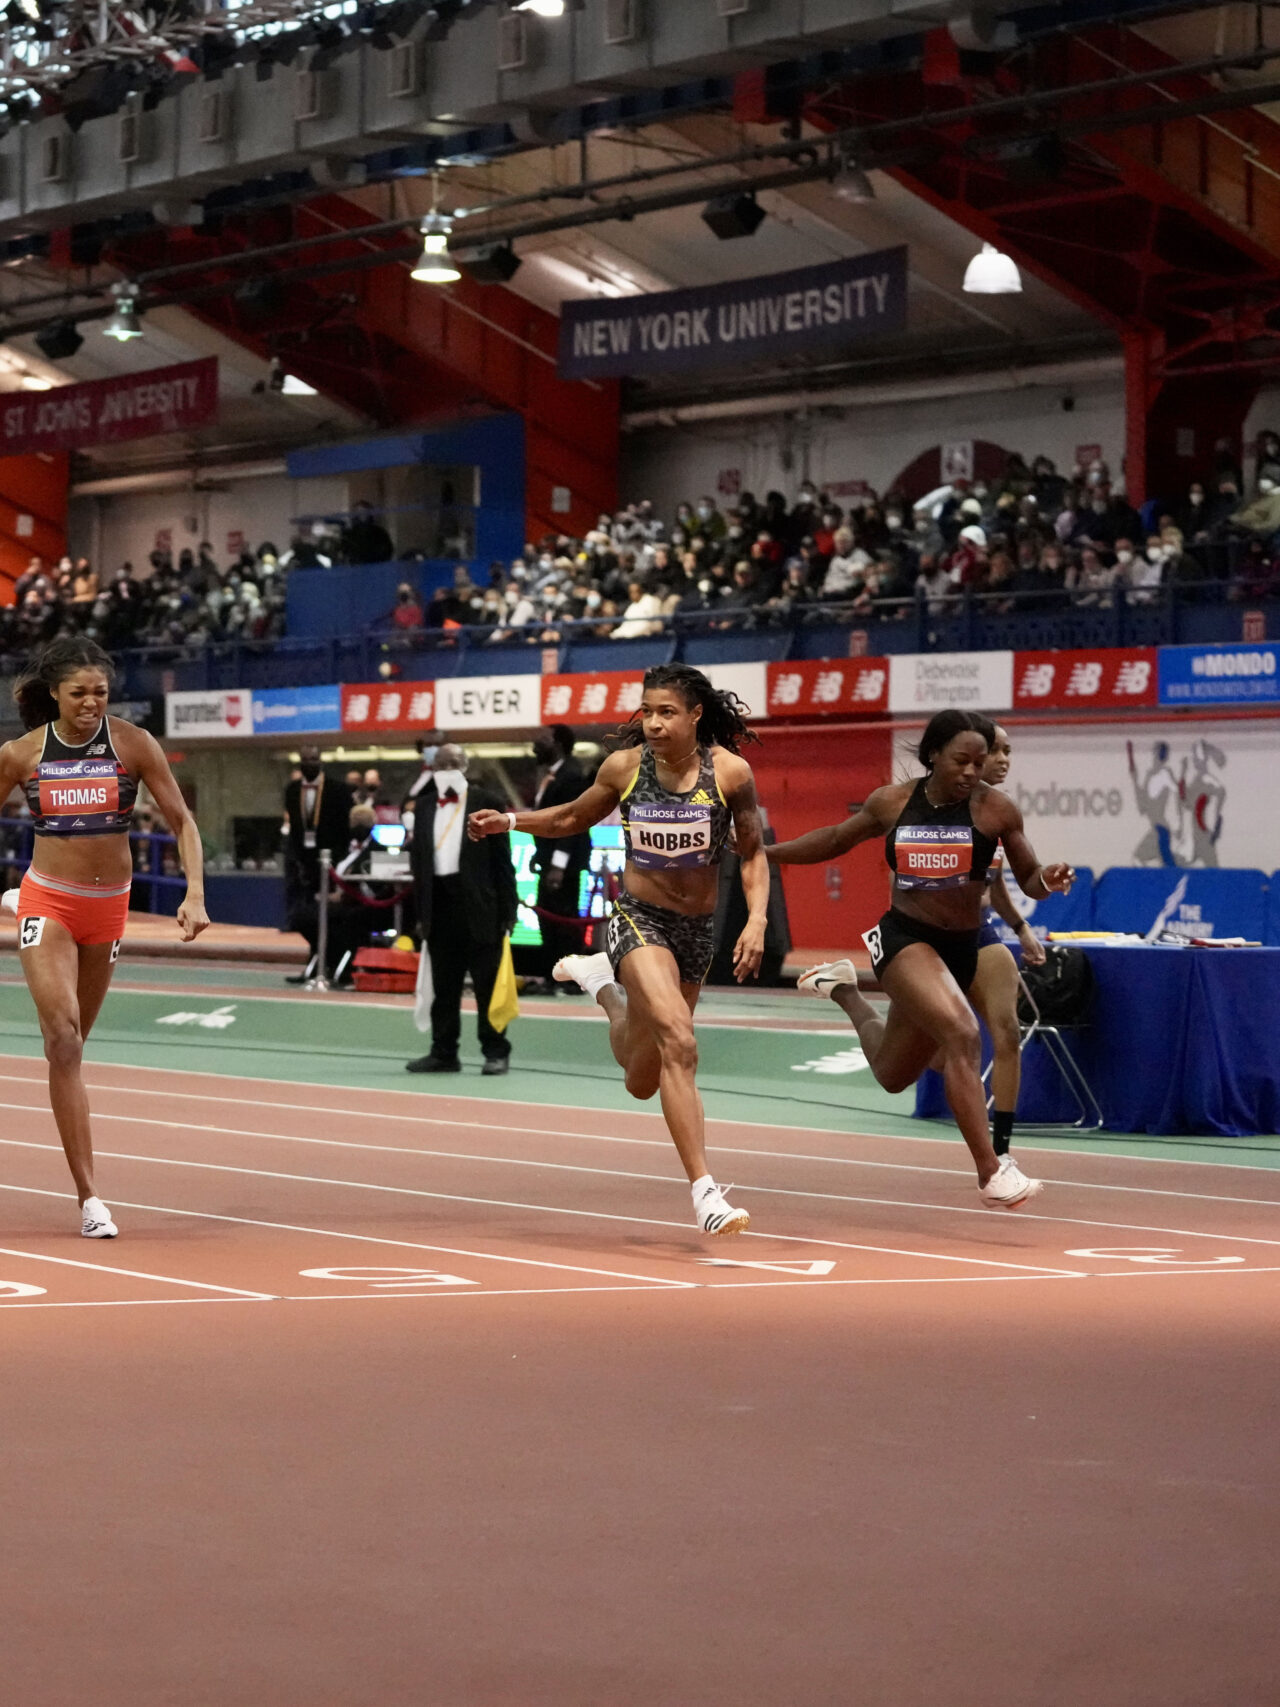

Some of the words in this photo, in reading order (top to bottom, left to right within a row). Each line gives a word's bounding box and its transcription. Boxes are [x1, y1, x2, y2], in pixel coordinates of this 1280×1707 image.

[573, 319, 632, 357] NEW
[638, 307, 710, 352] YORK
[719, 274, 889, 343] UNIVERSITY
[448, 689, 522, 715] LEVER
[41, 766, 82, 776] MILLROSE
[84, 764, 114, 774] GAMES
[50, 787, 107, 806] THOMAS
[1017, 782, 1122, 817] balance
[634, 808, 675, 819] MILLROSE
[677, 810, 708, 819] GAMES
[640, 830, 705, 851] HOBBS
[899, 831, 939, 839] MILLROSE
[940, 831, 969, 840] GAMES
[908, 853, 959, 869] BRISCO
[22, 917, 41, 945] 5
[868, 930, 883, 962] 3
